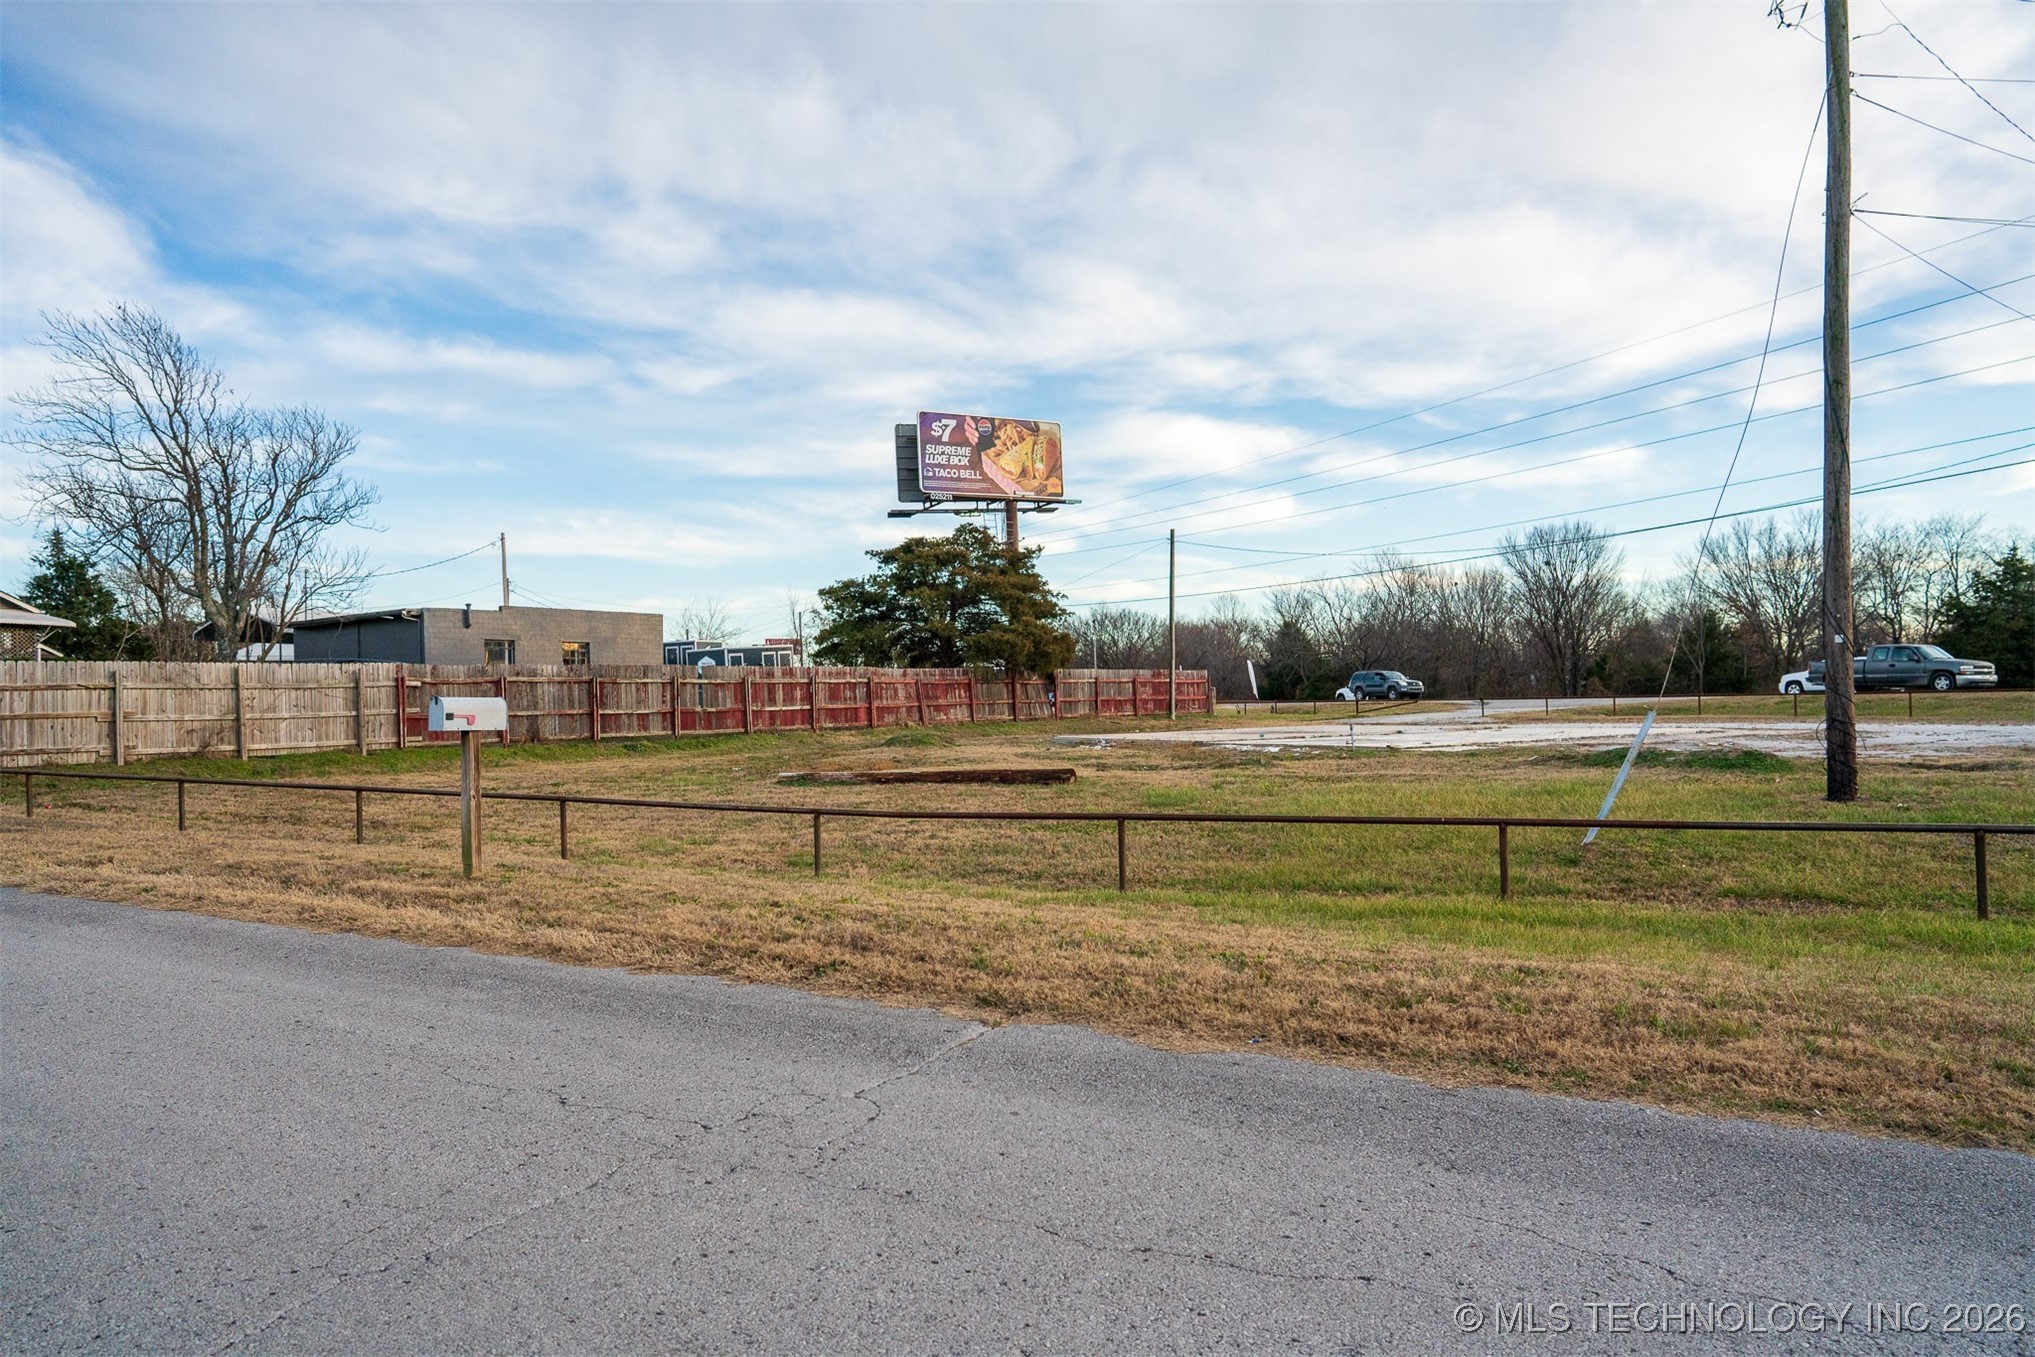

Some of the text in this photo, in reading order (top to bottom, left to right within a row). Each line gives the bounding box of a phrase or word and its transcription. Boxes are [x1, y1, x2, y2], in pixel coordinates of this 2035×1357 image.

[930, 418, 957, 442] $7
[925, 444, 972, 456] SUPREME
[925, 453, 970, 466] LUXE BOX
[933, 467, 983, 479] TACO BELL
